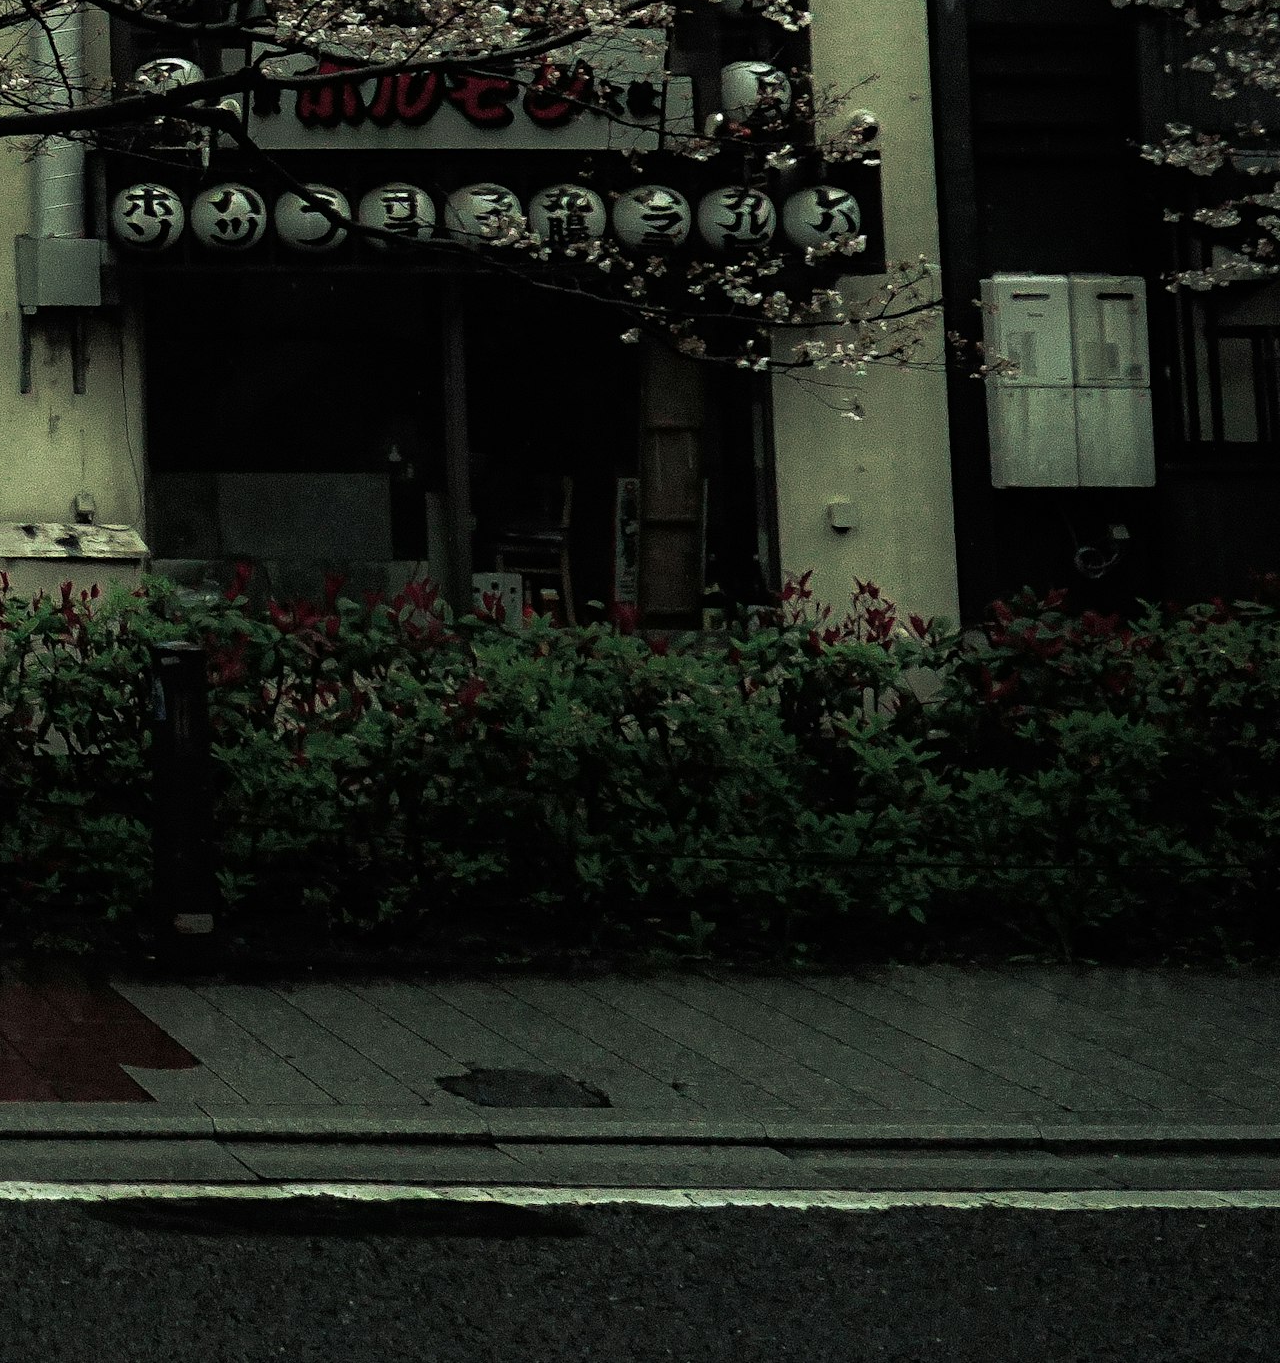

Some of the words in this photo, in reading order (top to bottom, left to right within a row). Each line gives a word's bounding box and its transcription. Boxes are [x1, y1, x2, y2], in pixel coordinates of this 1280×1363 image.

[296, 55, 593, 127] ホルモン
[124, 189, 173, 248] ホソ
[210, 191, 261, 248] ハツ
